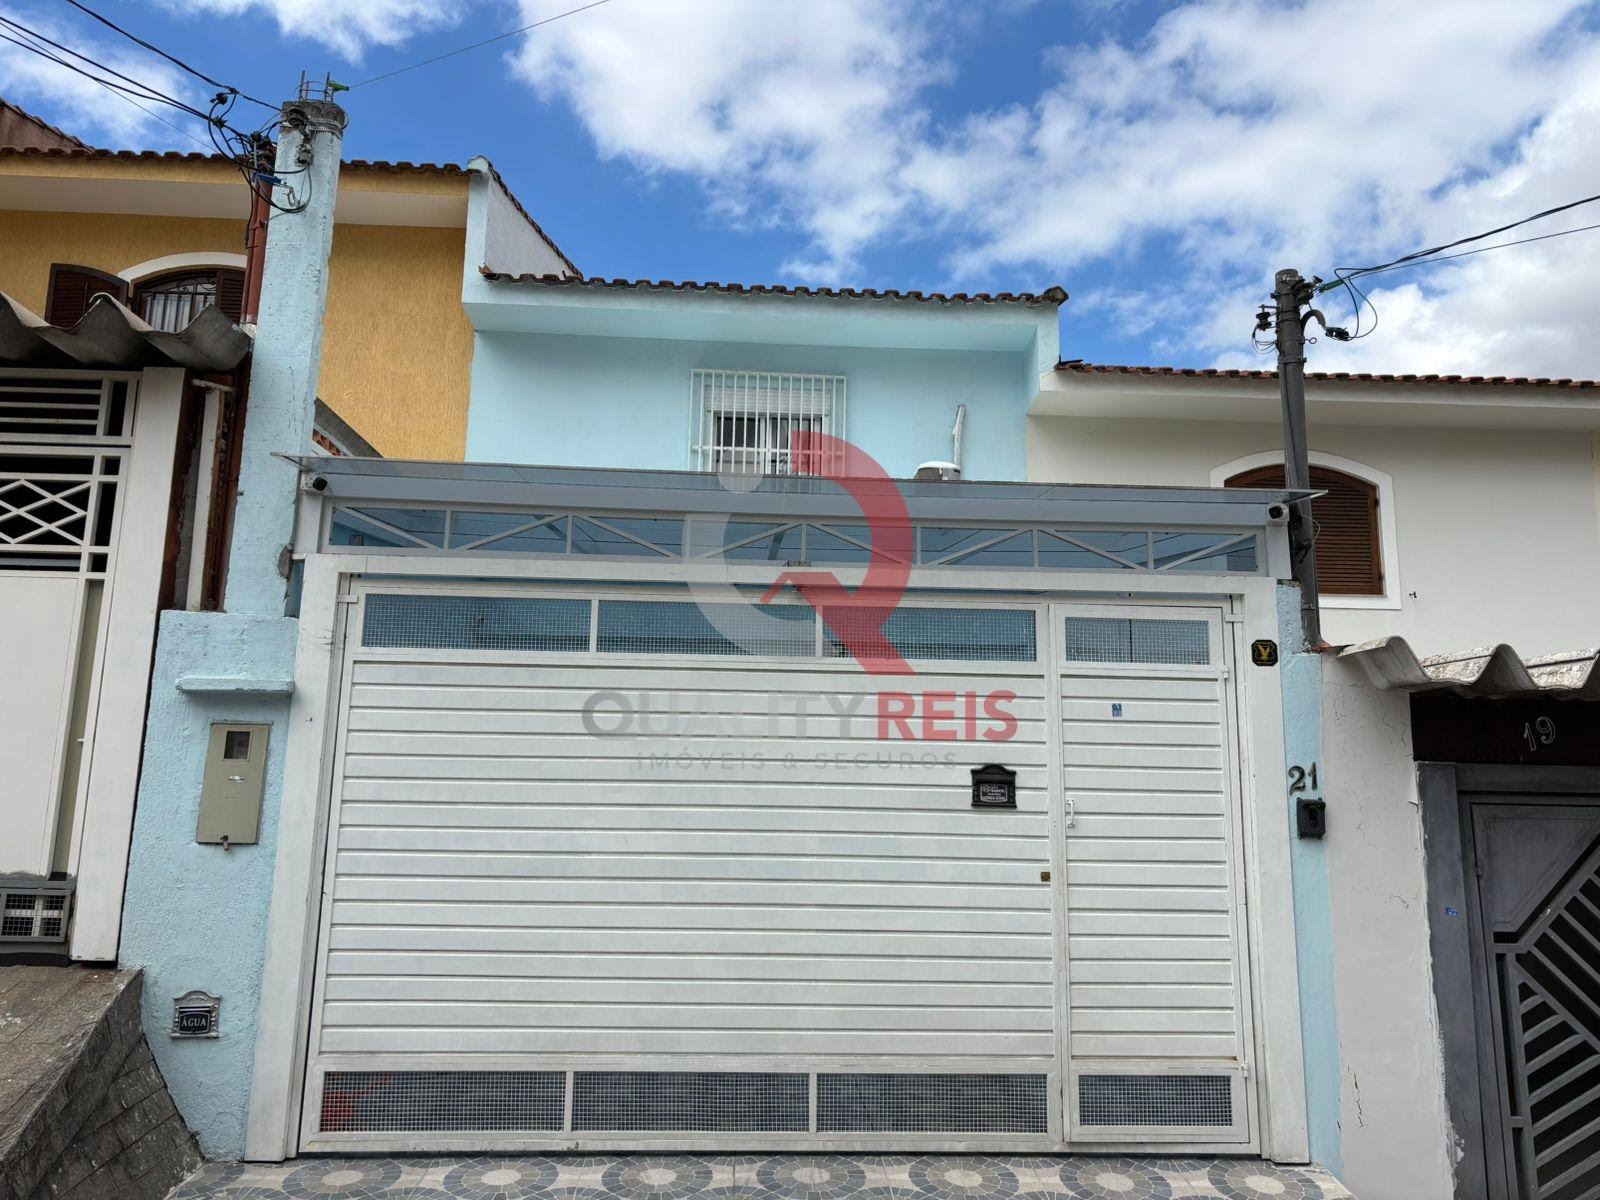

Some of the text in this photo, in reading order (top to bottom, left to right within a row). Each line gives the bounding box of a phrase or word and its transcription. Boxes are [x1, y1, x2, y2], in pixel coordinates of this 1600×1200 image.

[1523, 716, 1556, 752] 19
[1288, 761, 1318, 796] 21
[181, 1016, 207, 1028] ÁGUA
